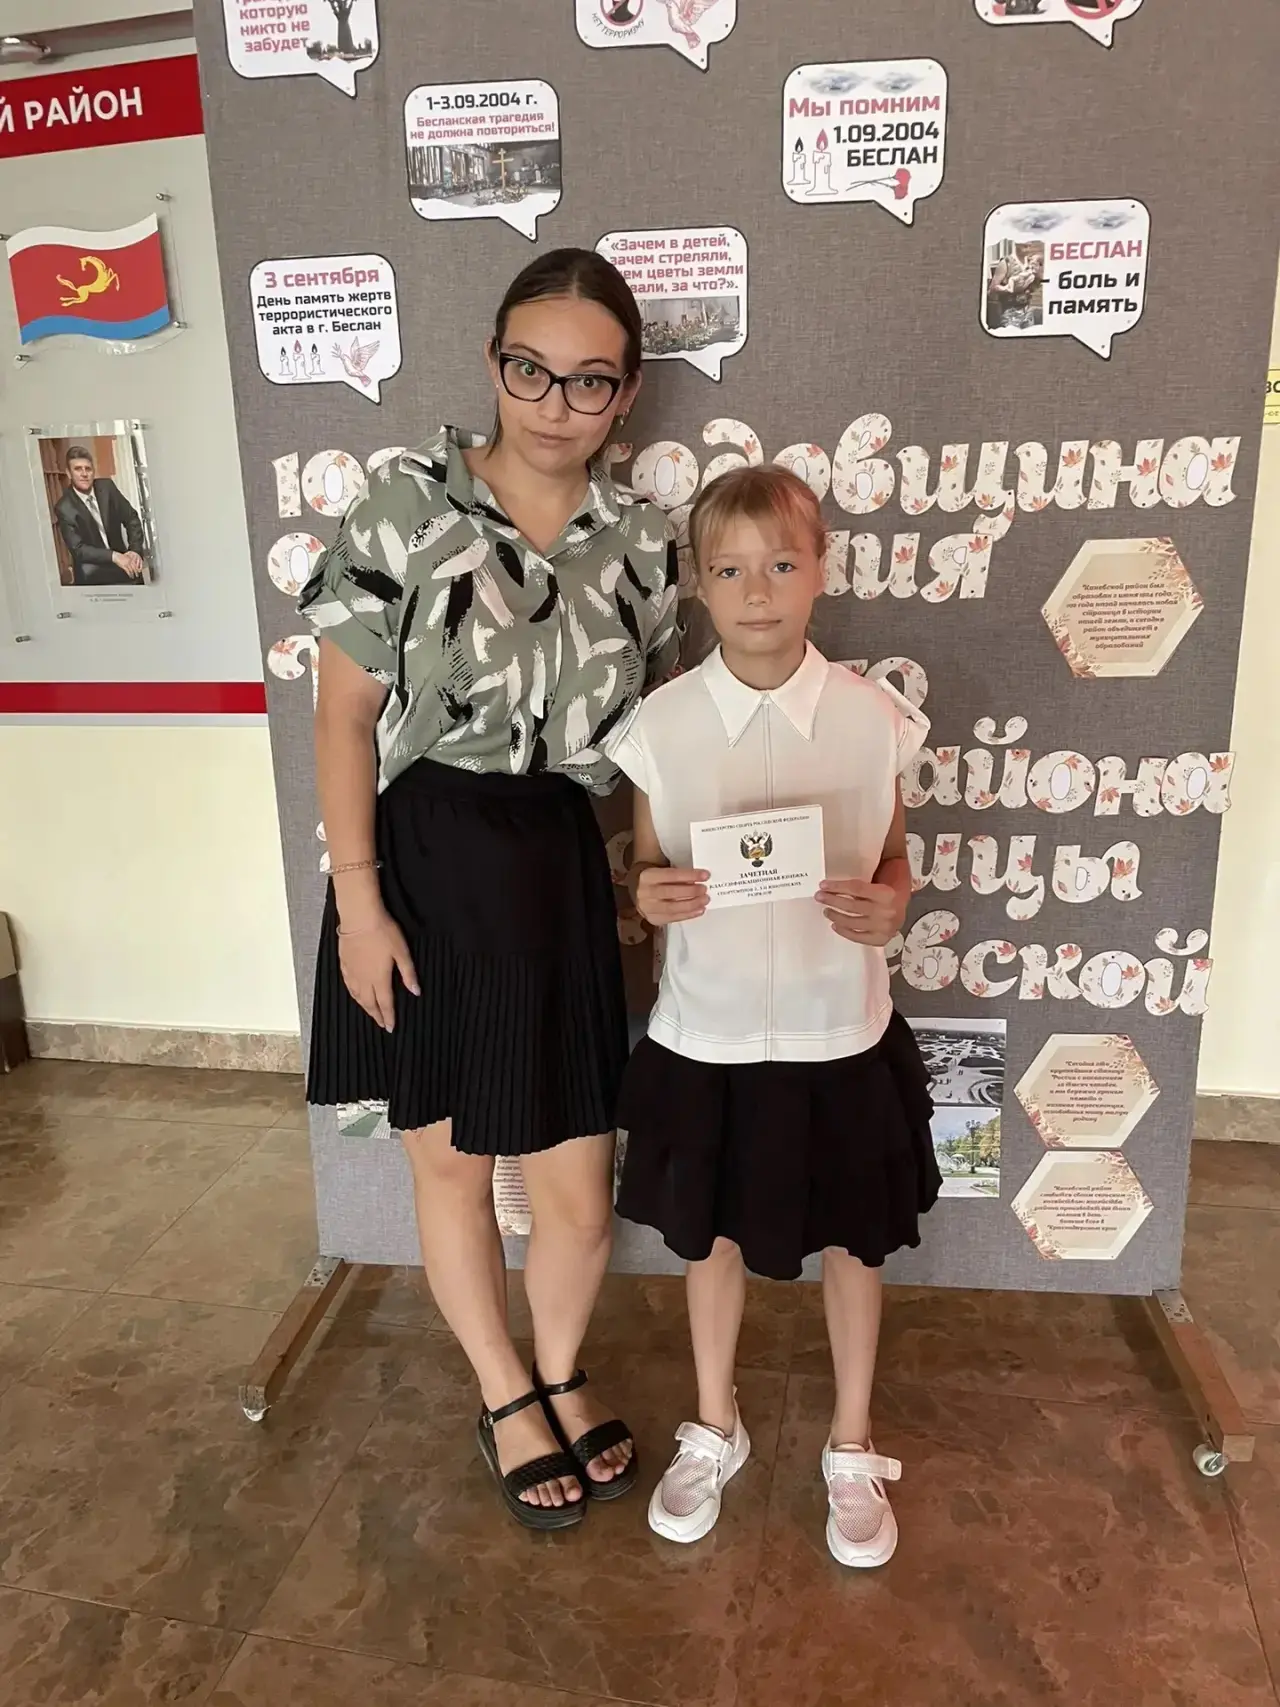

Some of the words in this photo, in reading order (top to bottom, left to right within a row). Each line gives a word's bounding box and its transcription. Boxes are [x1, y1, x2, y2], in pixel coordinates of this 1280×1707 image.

[240, 4, 308, 20] которую
[240, 22, 286, 36] никто
[291, 20, 310, 32] не
[24, 86, 143, 130] РАЙОН
[426, 92, 521, 110] 1-3.09.2004
[526, 93, 537, 105] г.
[789, 98, 831, 118] Мы
[839, 95, 940, 116] помним
[417, 115, 486, 127] Бесланская
[489, 112, 544, 125] трагедия
[410, 131, 424, 139] не
[428, 127, 473, 140] должна
[477, 122, 555, 136] повториться!
[833, 121, 939, 144] 1.09.2004
[847, 146, 938, 168] БЕСЛАН
[611, 238, 665, 251] «Зачем
[670, 239, 679, 249] в
[683, 233, 731, 250] детей,
[1049, 240, 1143, 261] БЕСЛАН
[610, 254, 654, 266] зачем
[659, 250, 731, 266] стреляли,
[264, 271, 277, 288] 3
[283, 267, 380, 287] сентября
[647, 267, 694, 280] цветы
[697, 264, 744, 276] земли
[1058, 270, 1118, 290] боль
[1125, 272, 1140, 287] и
[630, 283, 668, 294] вали,
[671, 281, 688, 292] за
[257, 295, 291, 308] День
[295, 293, 345, 305] память
[348, 291, 392, 302] жертв
[1048, 298, 1138, 315] память
[259, 305, 392, 323] террористического
[272, 325, 303, 335] акта
[307, 324, 315, 333] в
[318, 323, 329, 333] г.
[332, 320, 382, 332] Беслан
[901, 716, 1235, 818] айона
